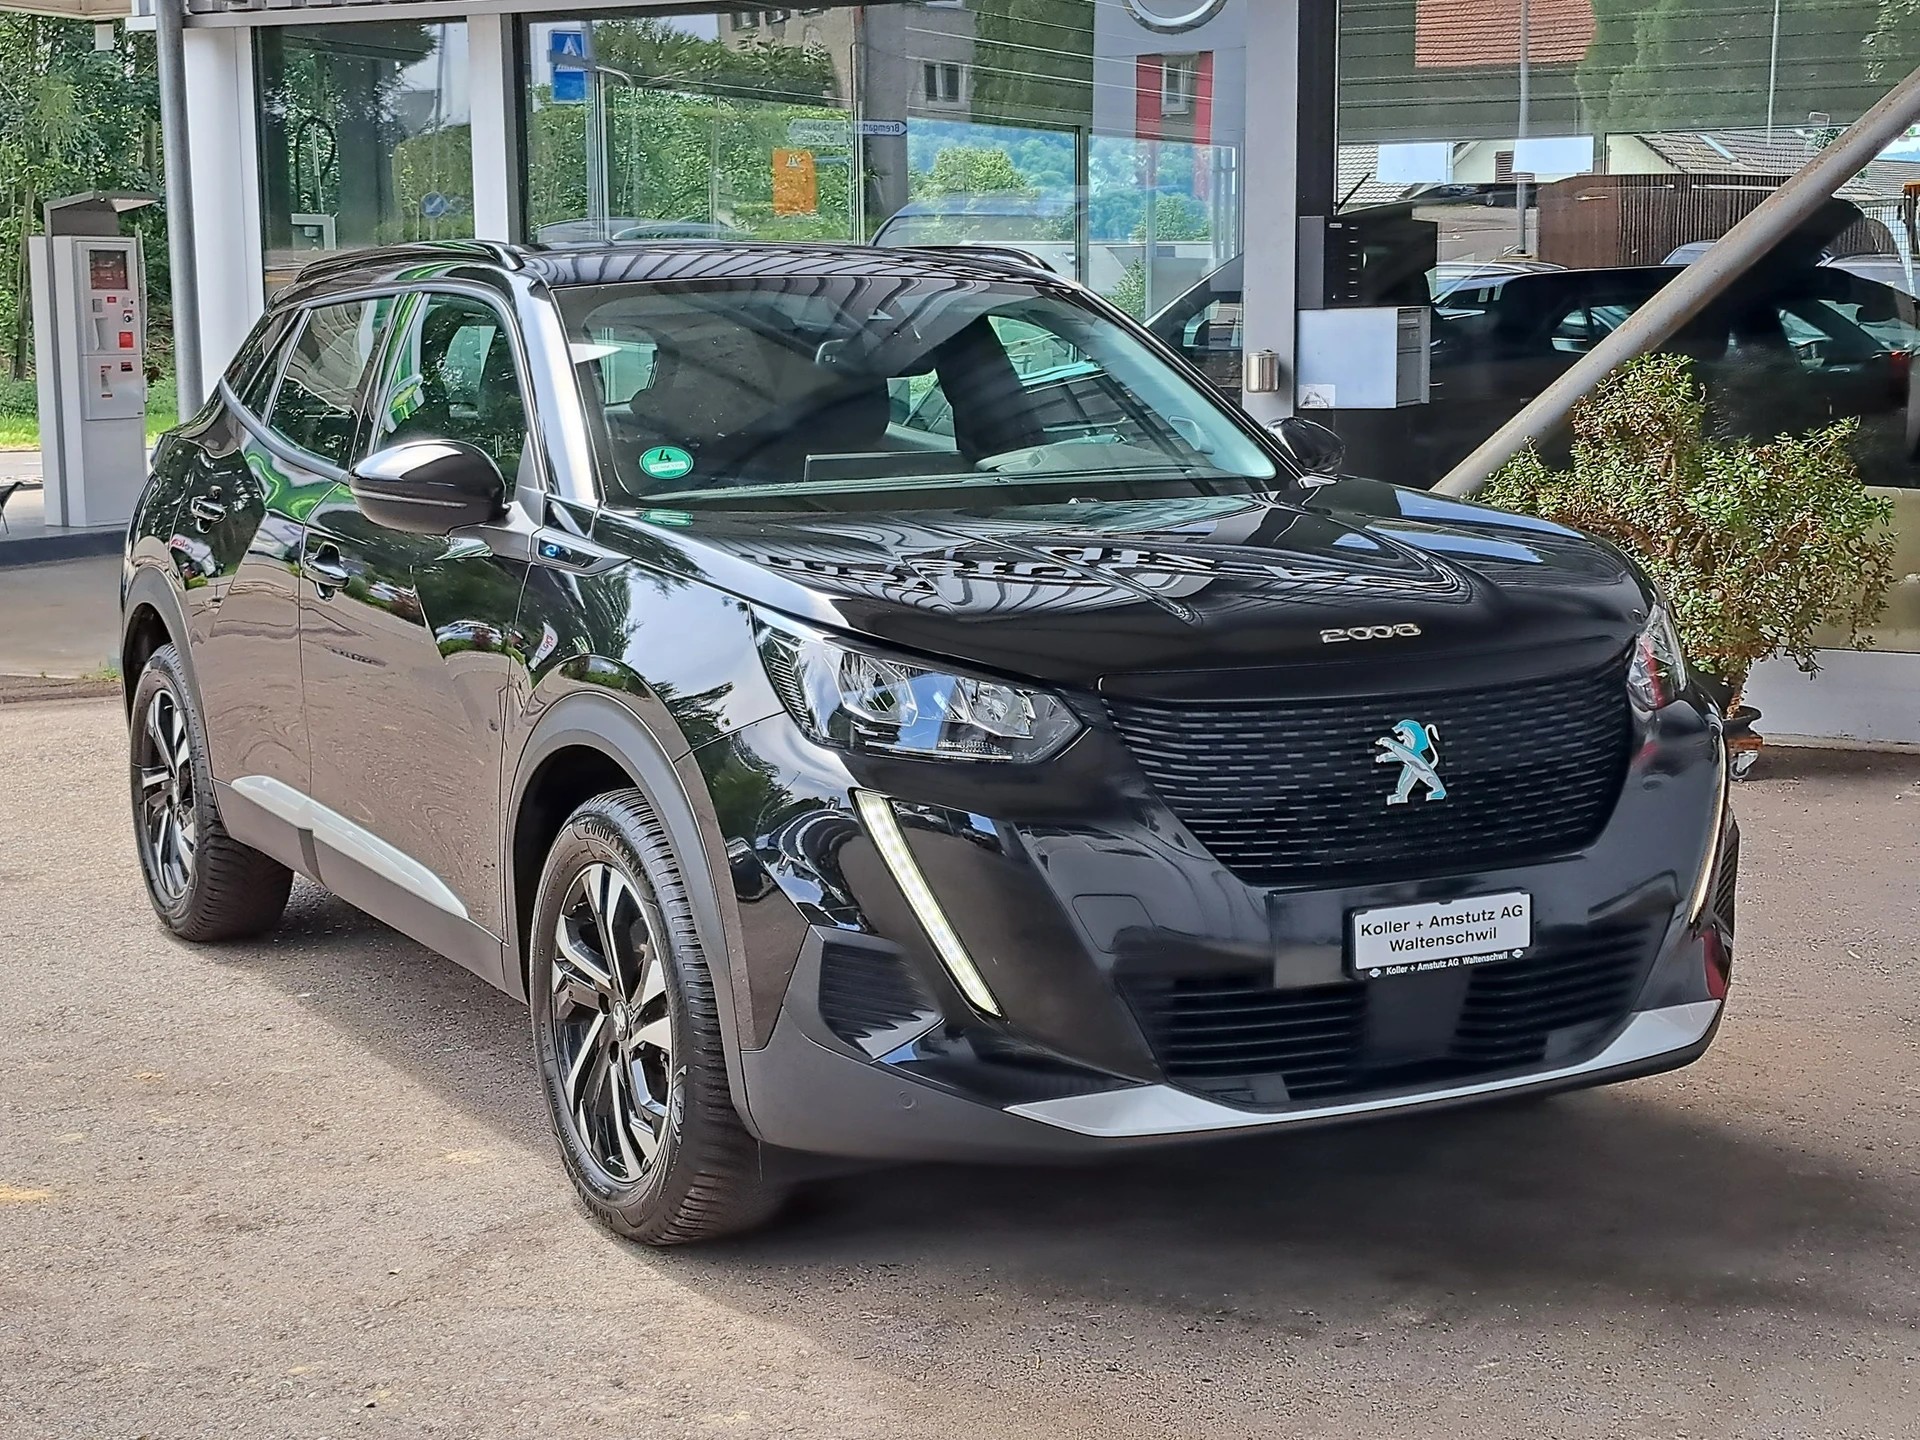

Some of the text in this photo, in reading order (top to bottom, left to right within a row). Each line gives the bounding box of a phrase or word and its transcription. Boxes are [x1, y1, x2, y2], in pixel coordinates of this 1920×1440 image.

[658, 449, 672, 462] 4
[1320, 623, 1421, 643] 2008
[1361, 904, 1523, 937] Koller + Amstutz AG
[1389, 926, 1497, 953] Waltenschwil
[1386, 965, 1408, 976] Koller
[1410, 964, 1416, 972] +
[1417, 960, 1447, 972] Amstutz
[1447, 958, 1460, 968] AG
[1462, 951, 1508, 965] Waltenschwil
